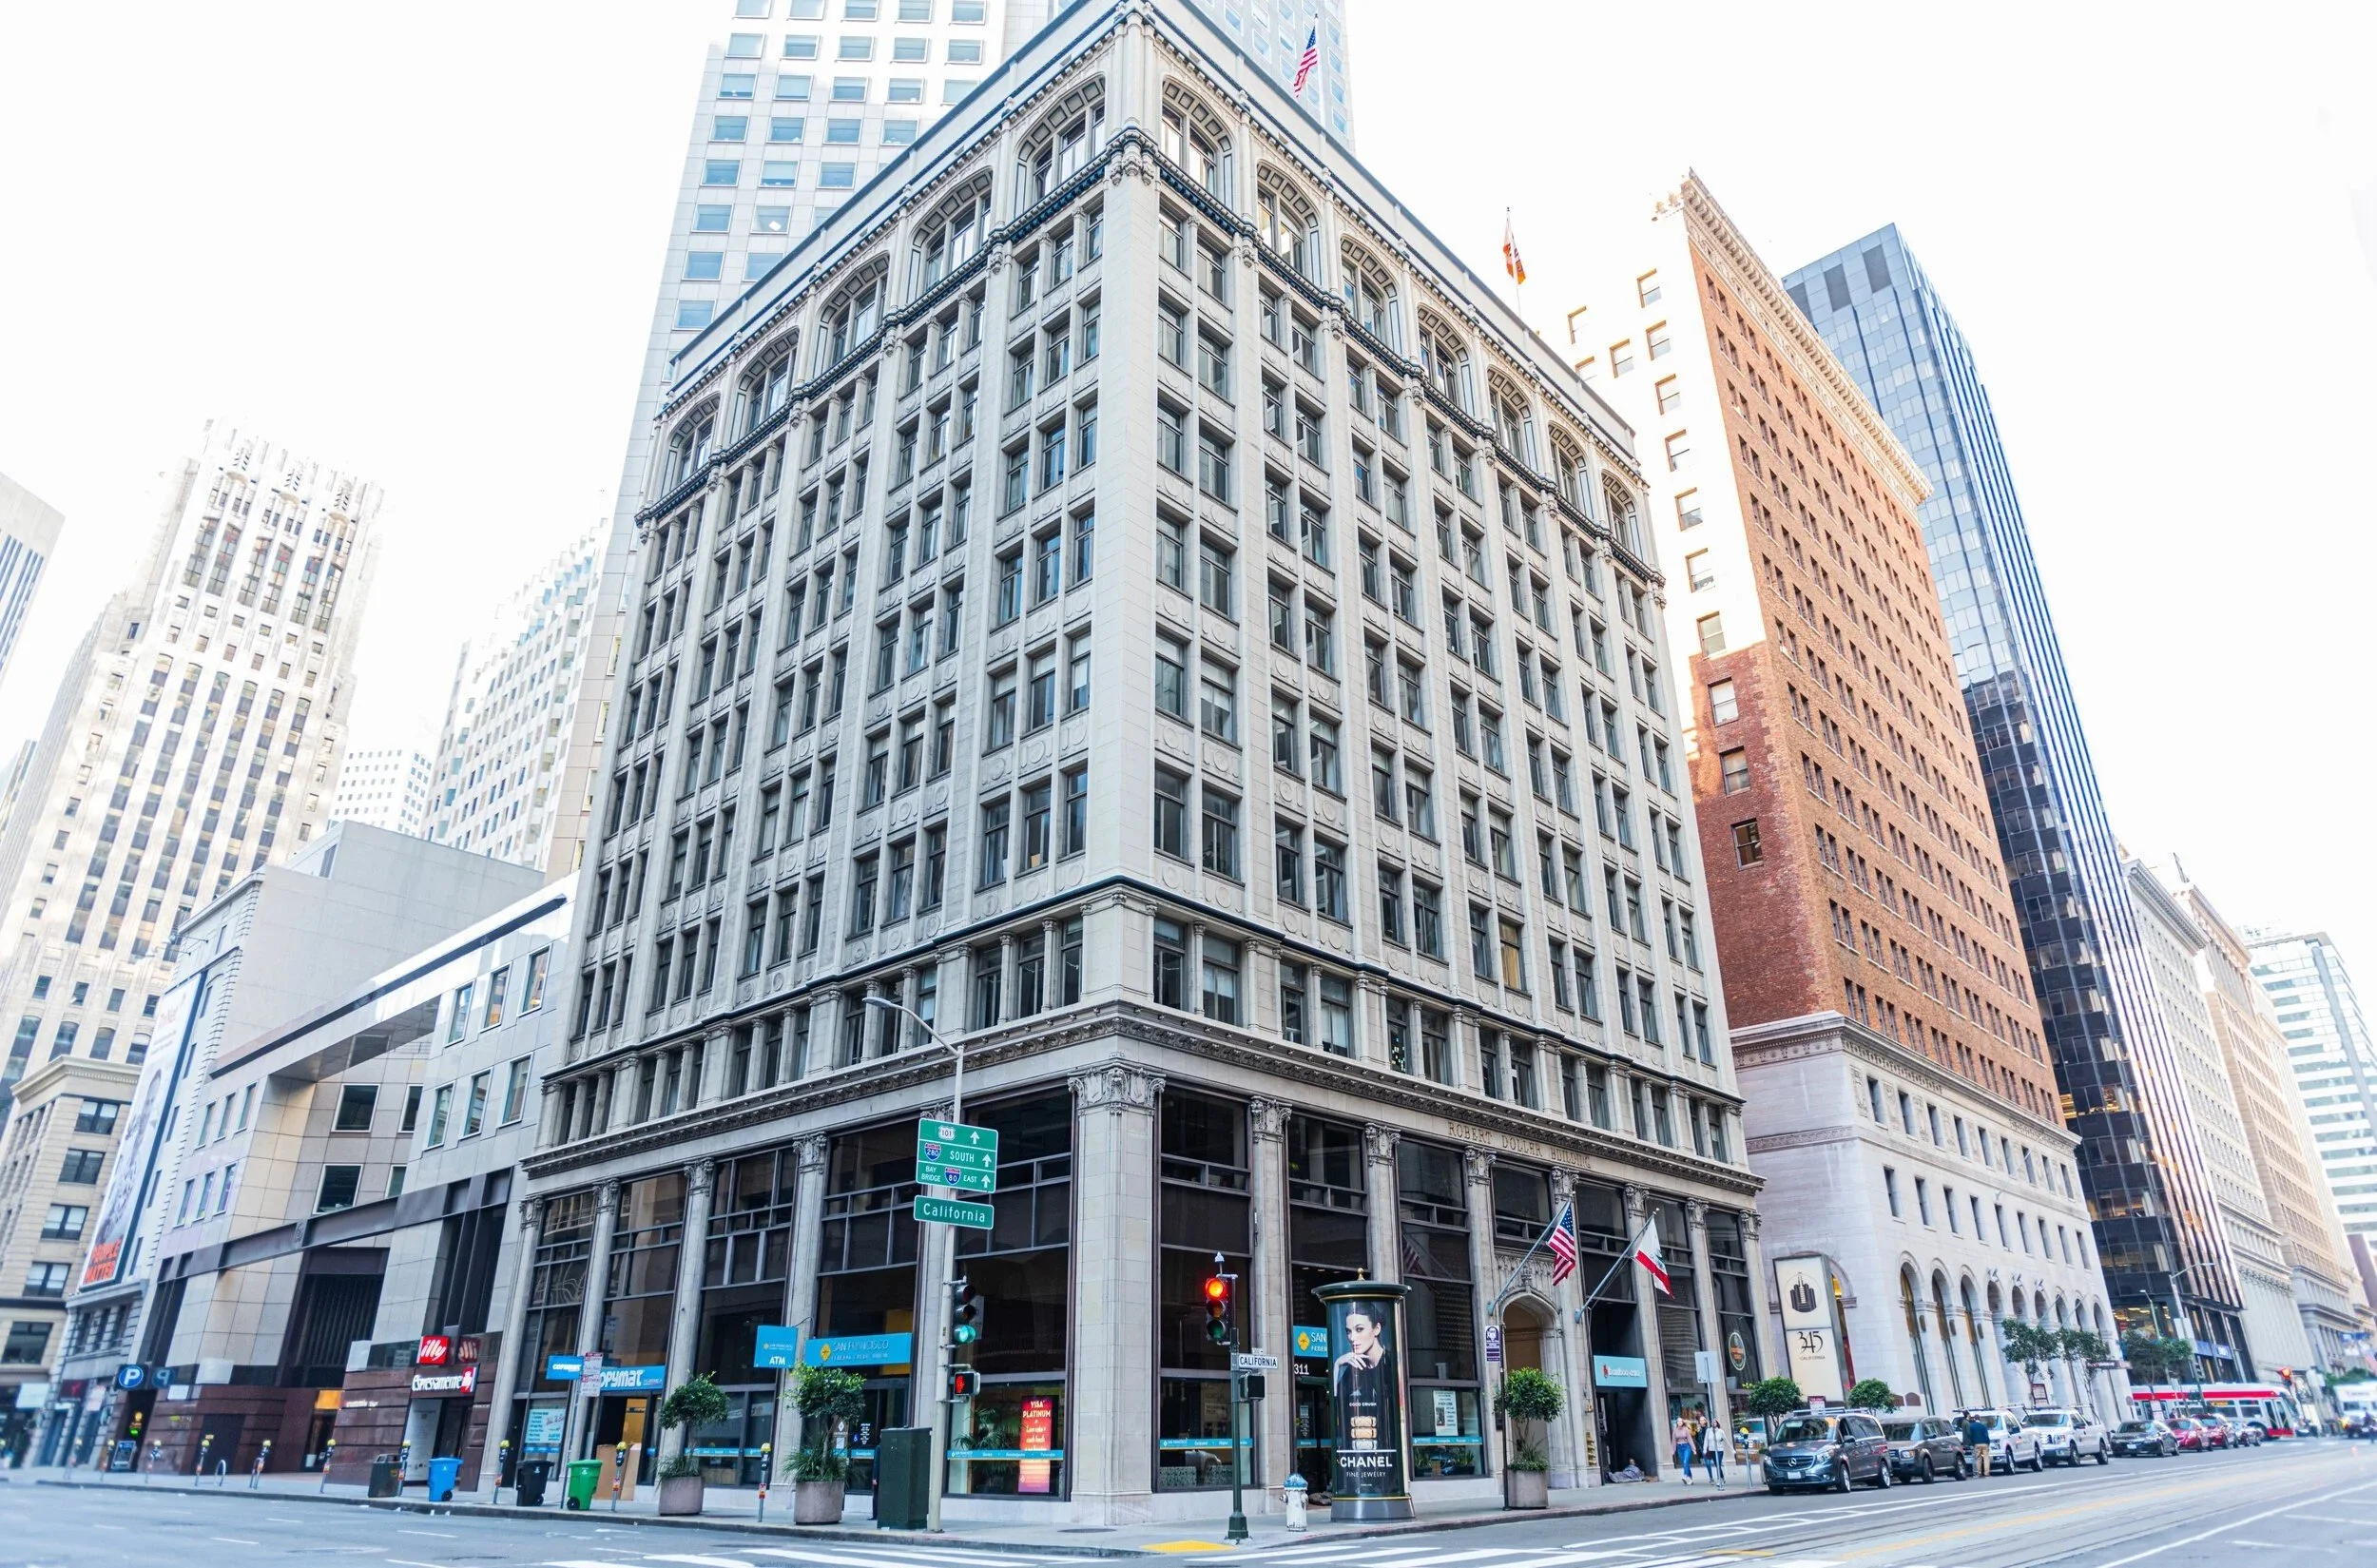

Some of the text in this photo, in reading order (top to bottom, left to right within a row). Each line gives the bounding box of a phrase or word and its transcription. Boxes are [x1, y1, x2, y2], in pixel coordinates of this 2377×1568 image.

[1447, 1121, 1592, 1169] ROBERT DOLLAR BUILDING
[949, 1151, 975, 1163] SOUTH
[920, 1173, 940, 1182] BRIDGE
[963, 1174, 977, 1183] EAST
[923, 1203, 985, 1223] California
[1311, 1331, 1326, 1343] SAN
[1797, 1330, 1824, 1354] 345
[420, 1339, 447, 1362] illy
[832, 1339, 889, 1352] SAN FRANCISCO
[769, 1356, 785, 1365] ATM
[1239, 1356, 1277, 1366] CALIFORNIA
[1294, 1363, 1309, 1375] 311
[123, 1368, 141, 1385] P
[1022, 1409, 1051, 1418] PLATINUM
[1340, 1456, 1393, 1468] CHANEL
